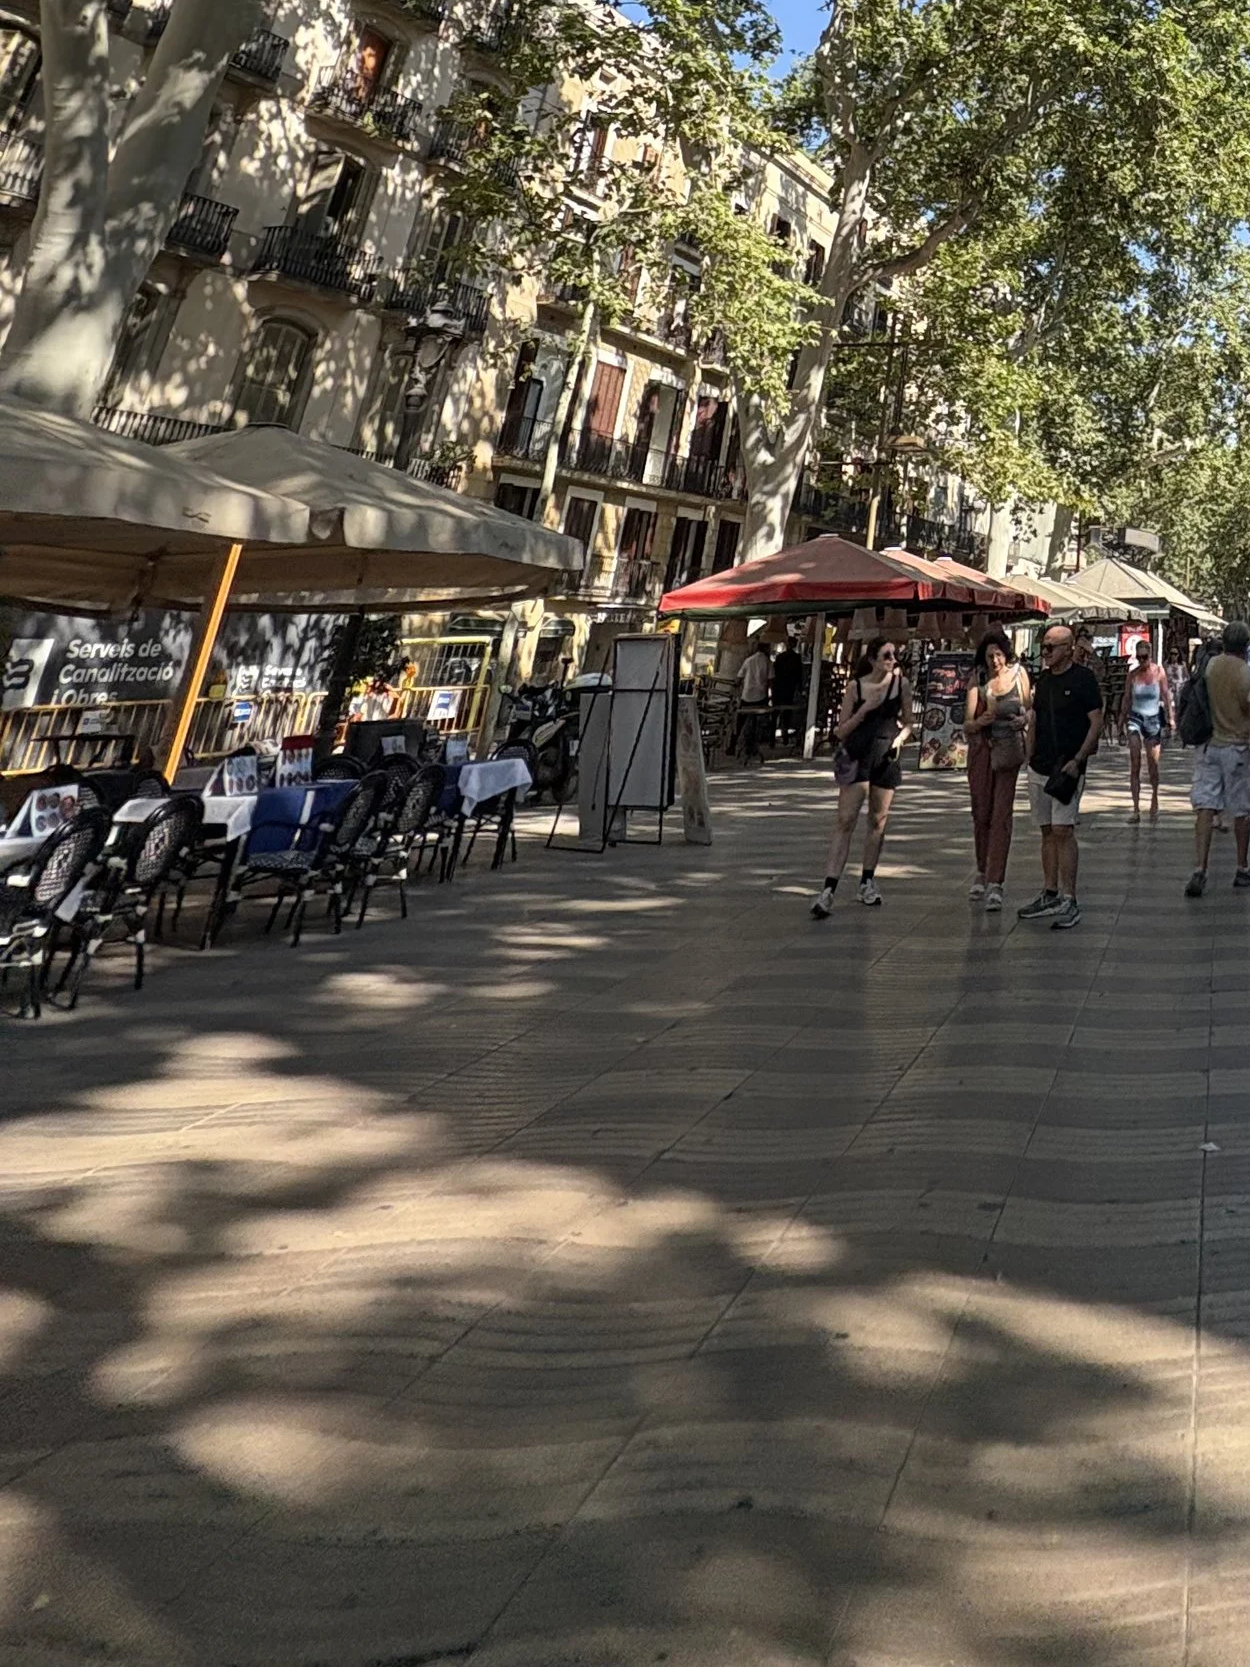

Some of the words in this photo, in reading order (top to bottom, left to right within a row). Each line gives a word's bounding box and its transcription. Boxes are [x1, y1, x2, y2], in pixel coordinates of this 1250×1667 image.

[66, 638, 135, 659] Serveis
[138, 638, 162, 658] de
[59, 661, 174, 684] Canalització
